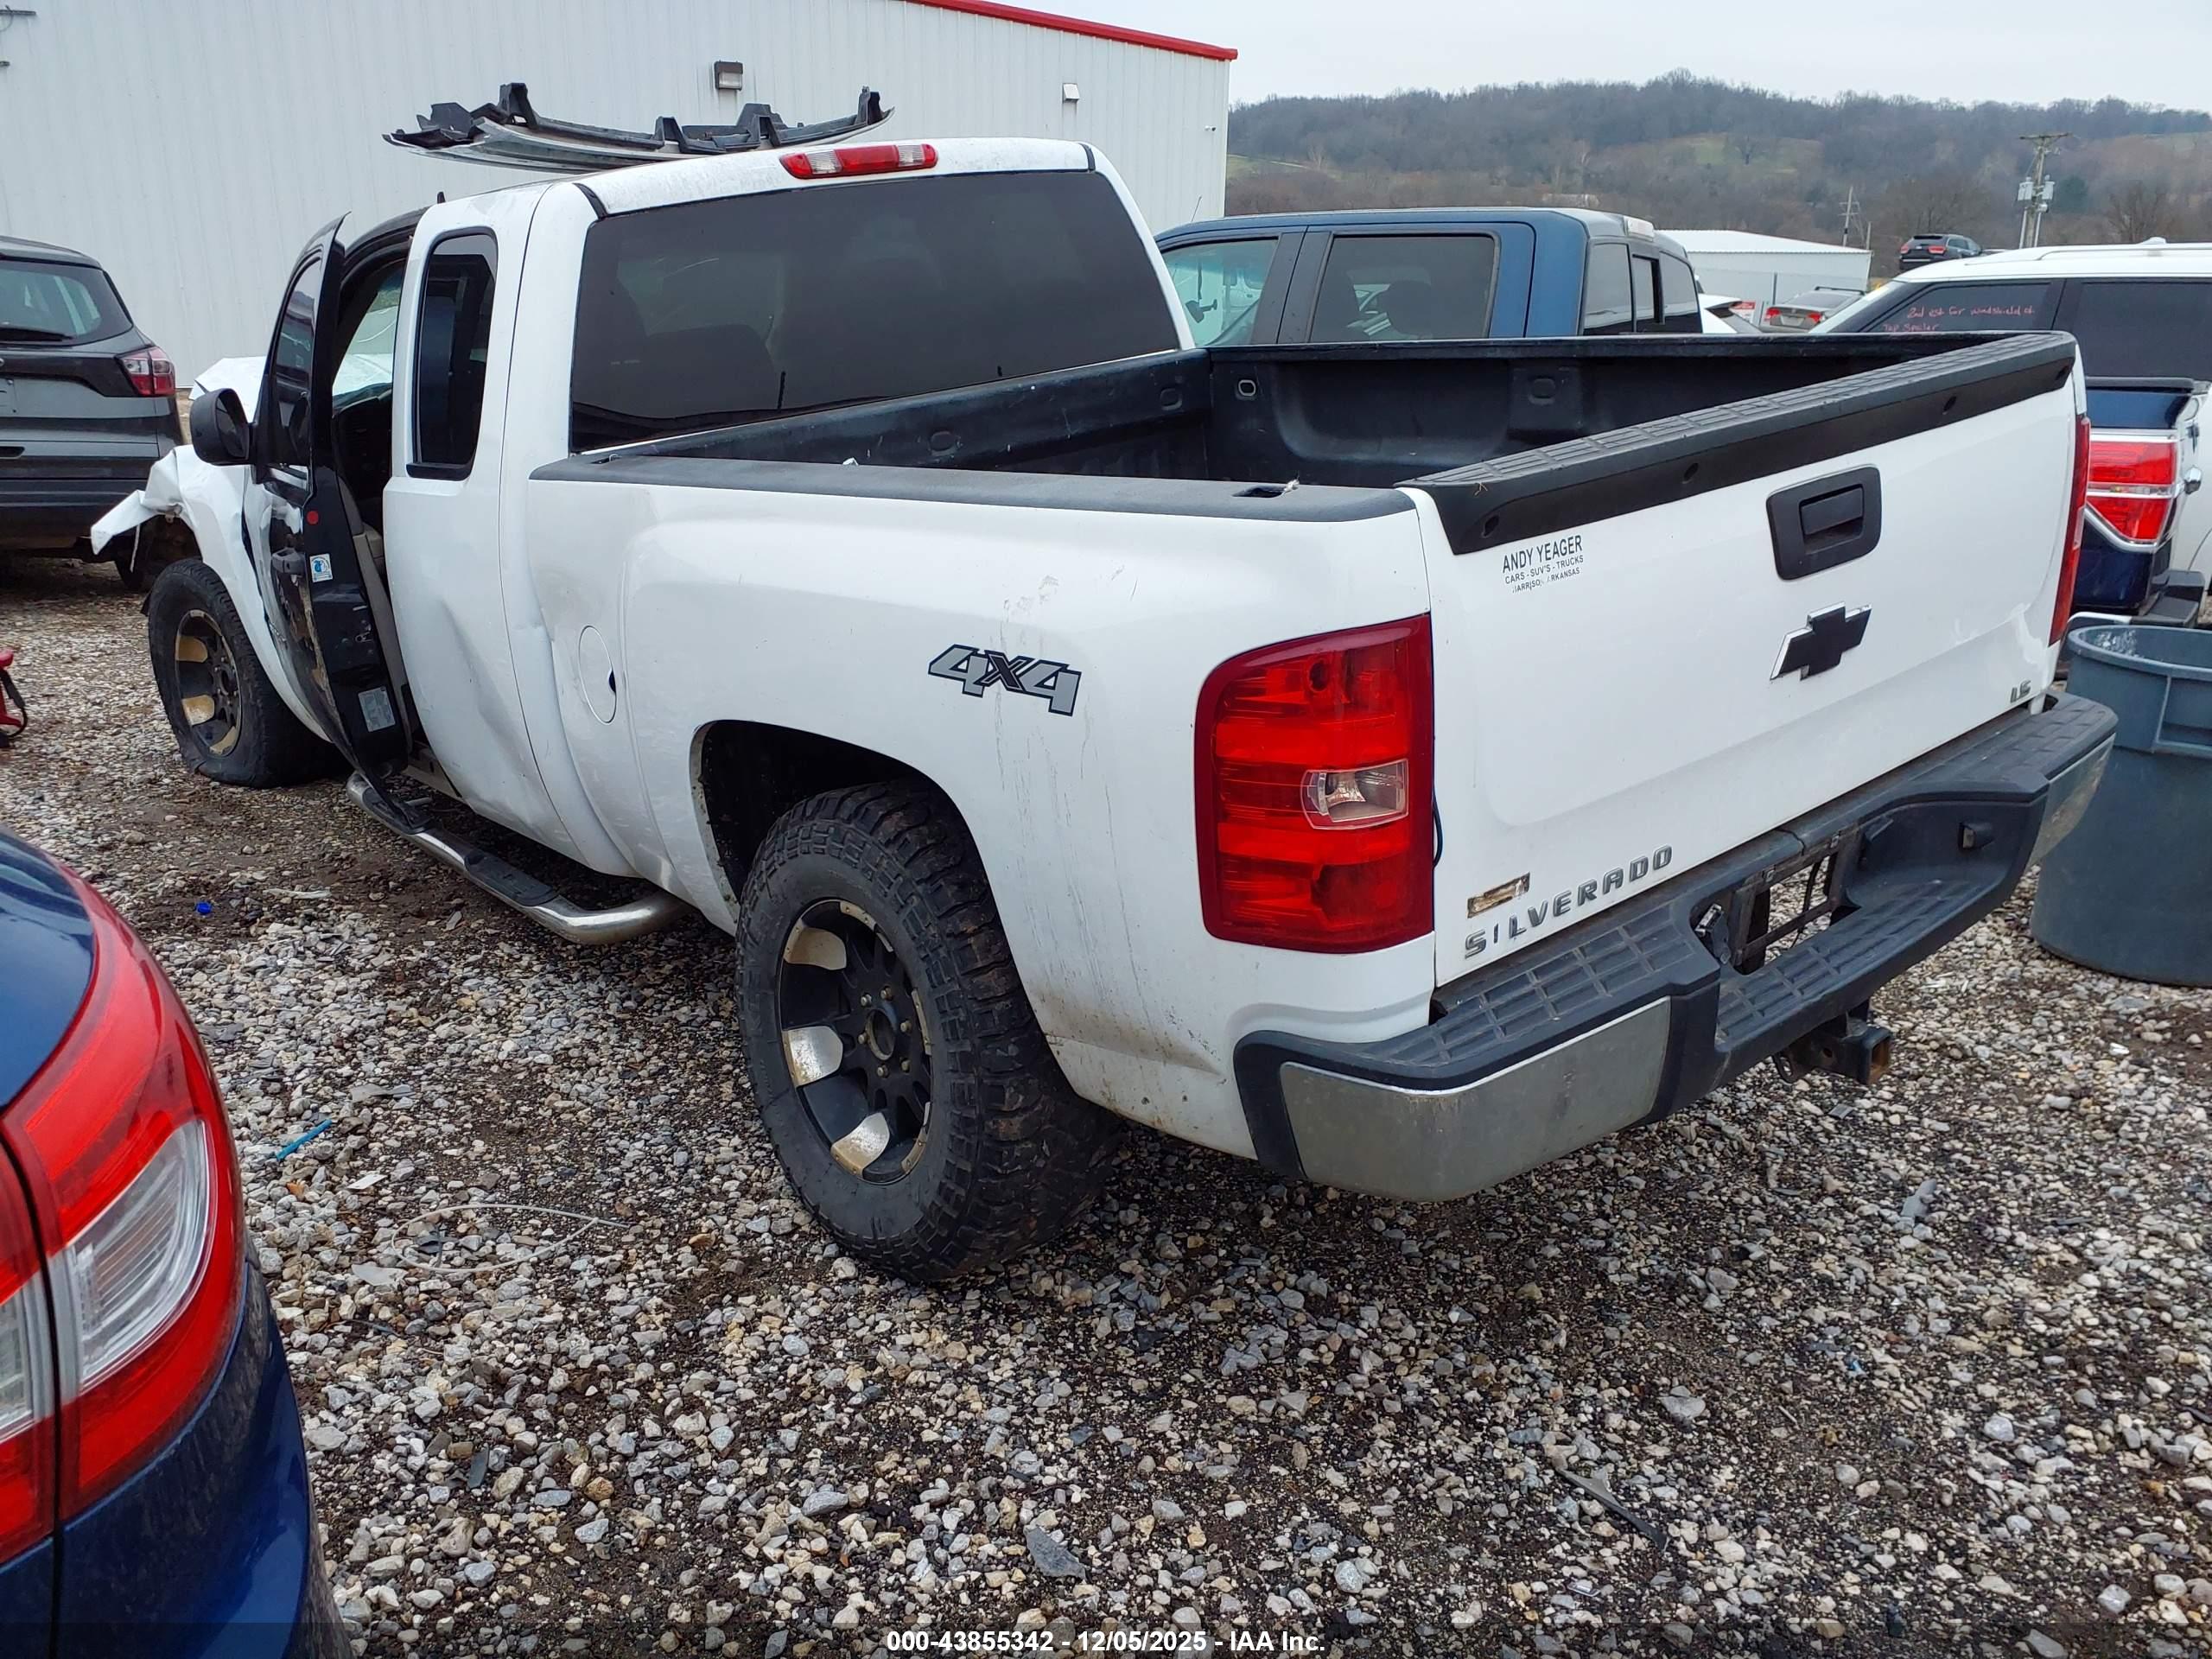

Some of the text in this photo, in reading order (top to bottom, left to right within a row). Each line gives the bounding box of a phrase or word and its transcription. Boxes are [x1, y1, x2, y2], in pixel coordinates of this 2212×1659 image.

[1503, 535, 1583, 573] ANDY YEAGER
[1505, 571, 1525, 584] CARS
[1556, 555, 1584, 570] TRUCKS
[1465, 843, 1673, 959] SILVERADO
